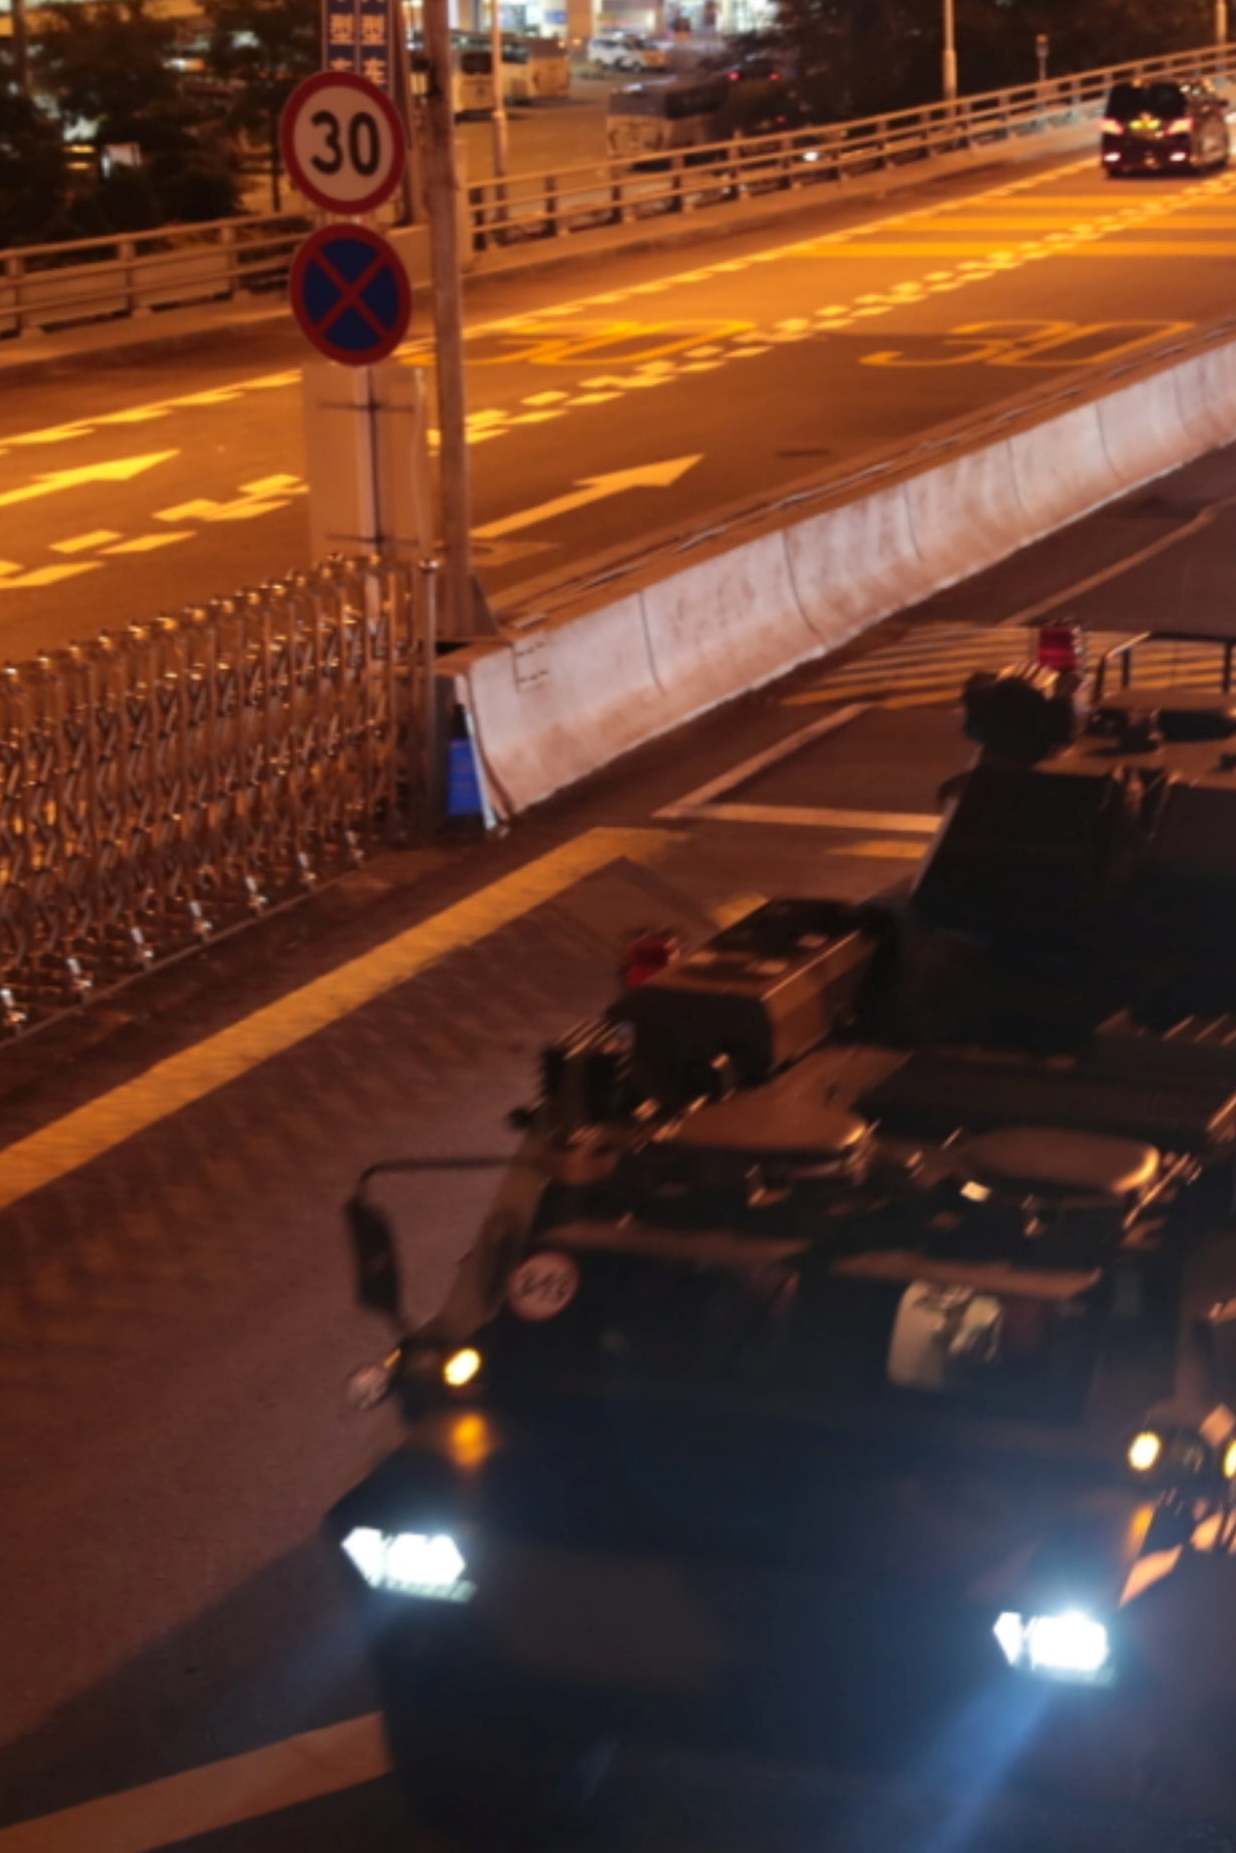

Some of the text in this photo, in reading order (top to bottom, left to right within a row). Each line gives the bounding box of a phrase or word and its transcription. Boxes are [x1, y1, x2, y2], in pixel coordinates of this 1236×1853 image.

[311, 110, 381, 176] 30
[400, 318, 754, 366] 30
[858, 319, 1196, 367] 30
